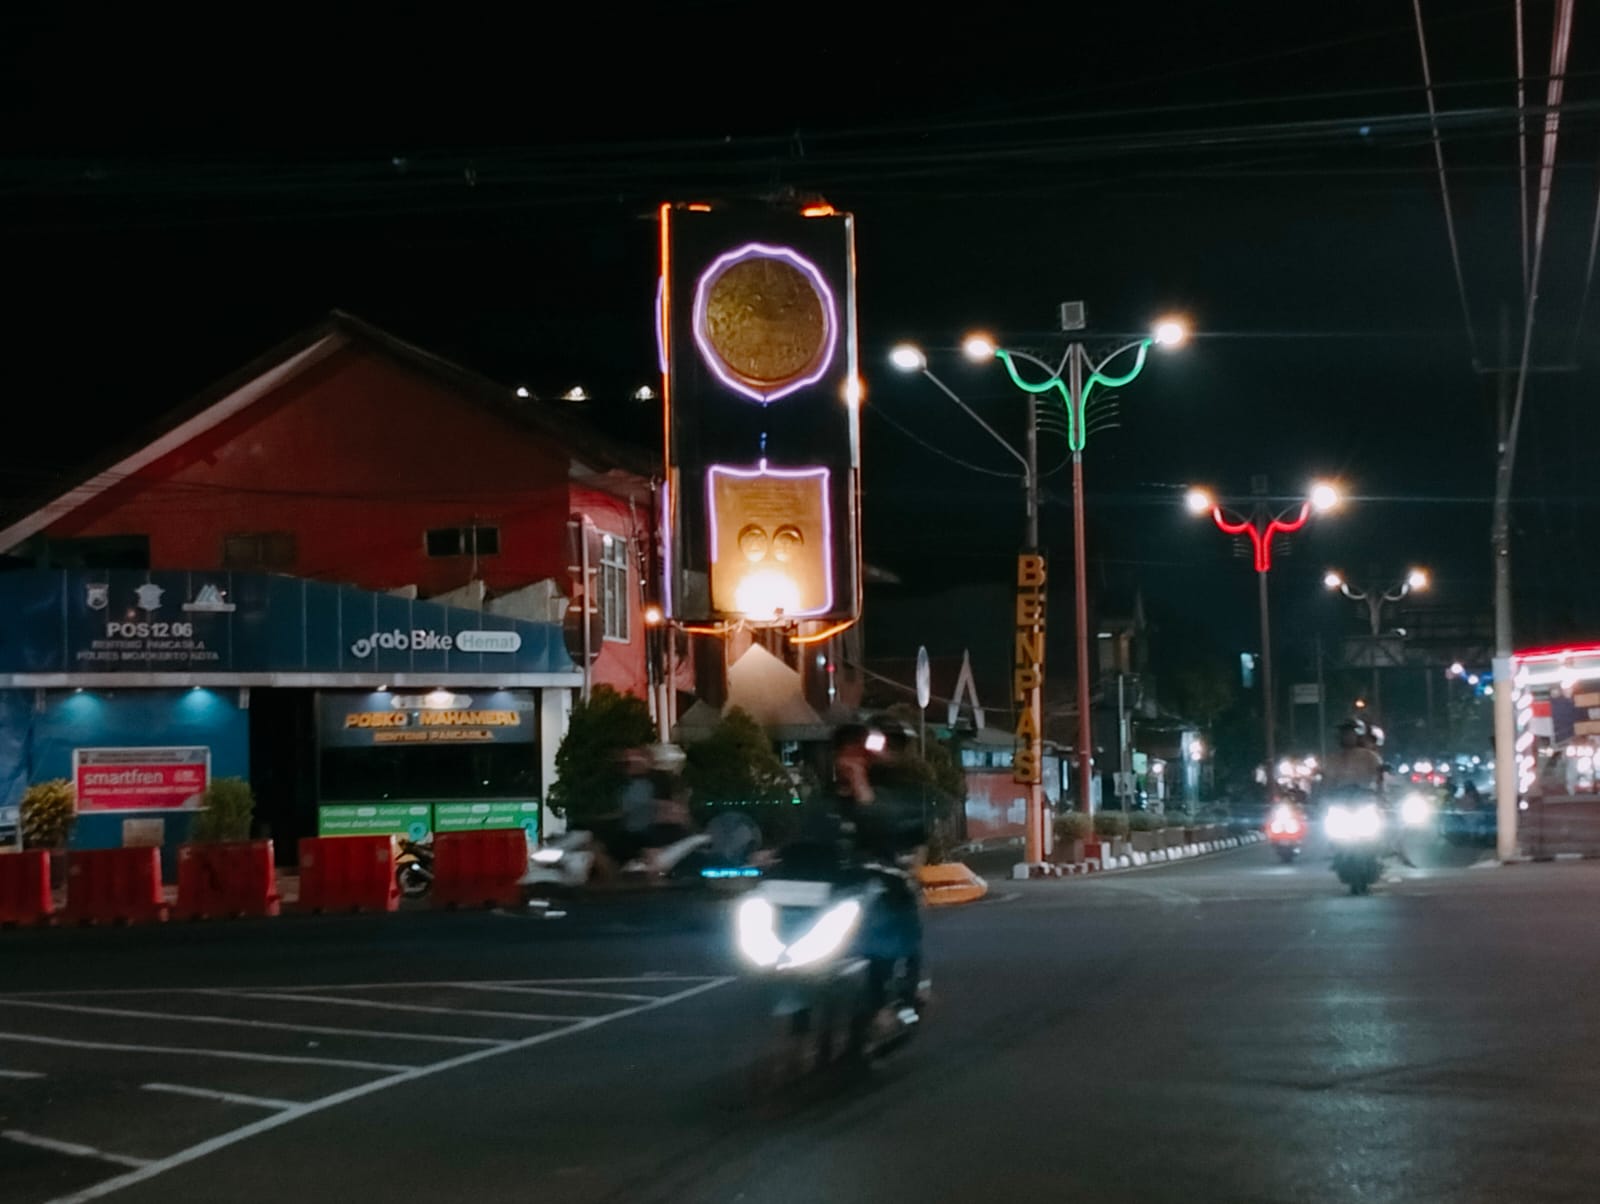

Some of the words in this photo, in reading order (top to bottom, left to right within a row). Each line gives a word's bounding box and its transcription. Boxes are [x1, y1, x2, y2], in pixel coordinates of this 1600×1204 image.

[107, 622, 150, 638] POS
[462, 633, 515, 650] Hemat
[1014, 554, 1046, 784] BENPAS
[345, 713, 407, 728] POSKO
[419, 710, 521, 726] MAHAMERU
[83, 769, 164, 785] smartfren
